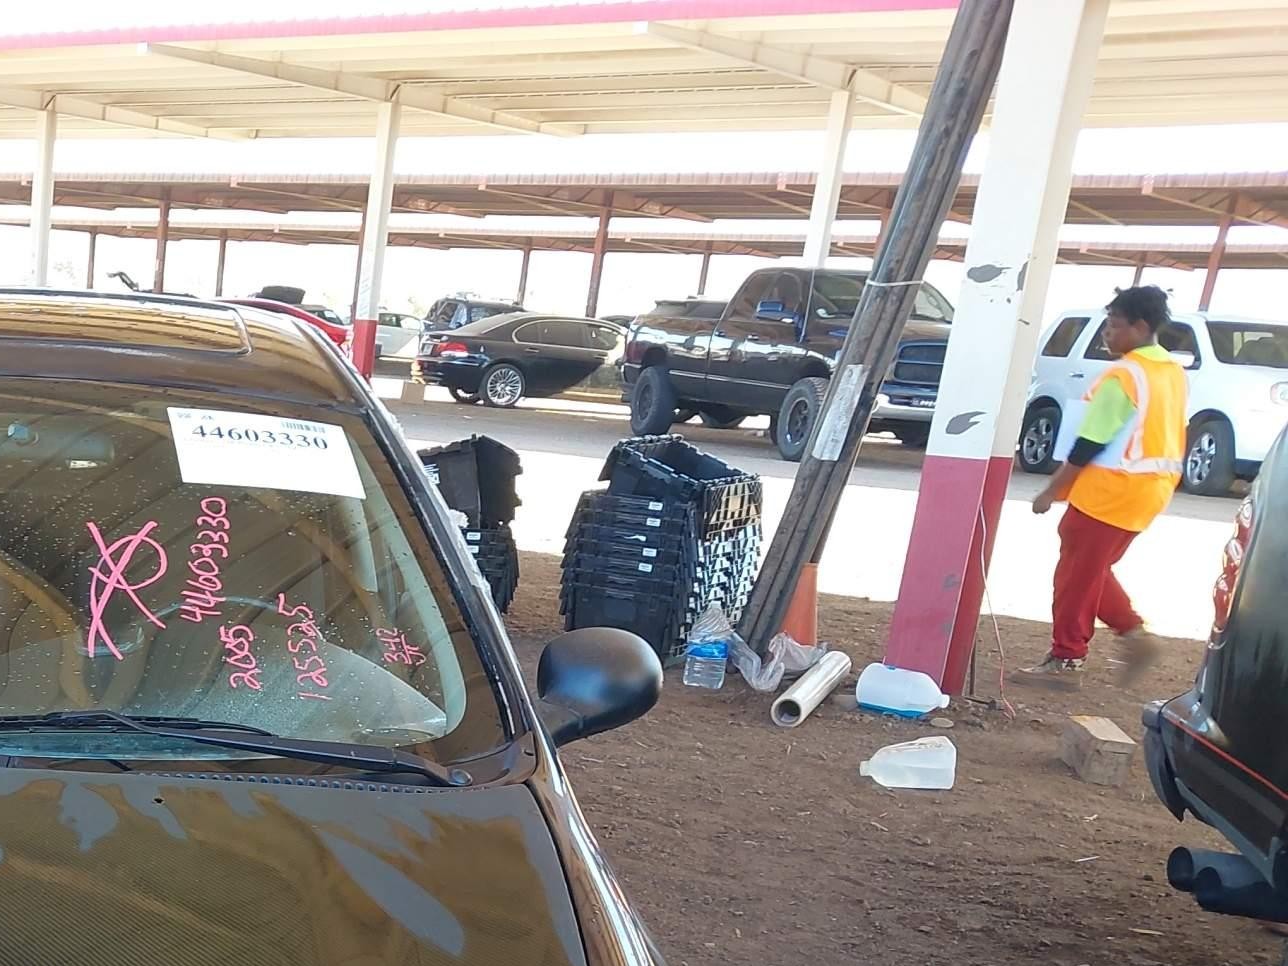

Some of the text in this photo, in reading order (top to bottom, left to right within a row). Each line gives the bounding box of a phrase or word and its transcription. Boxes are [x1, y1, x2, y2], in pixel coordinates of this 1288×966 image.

[192, 424, 329, 450] 44603330
[179, 497, 231, 624] 44603330
[219, 624, 262, 690] 2005
